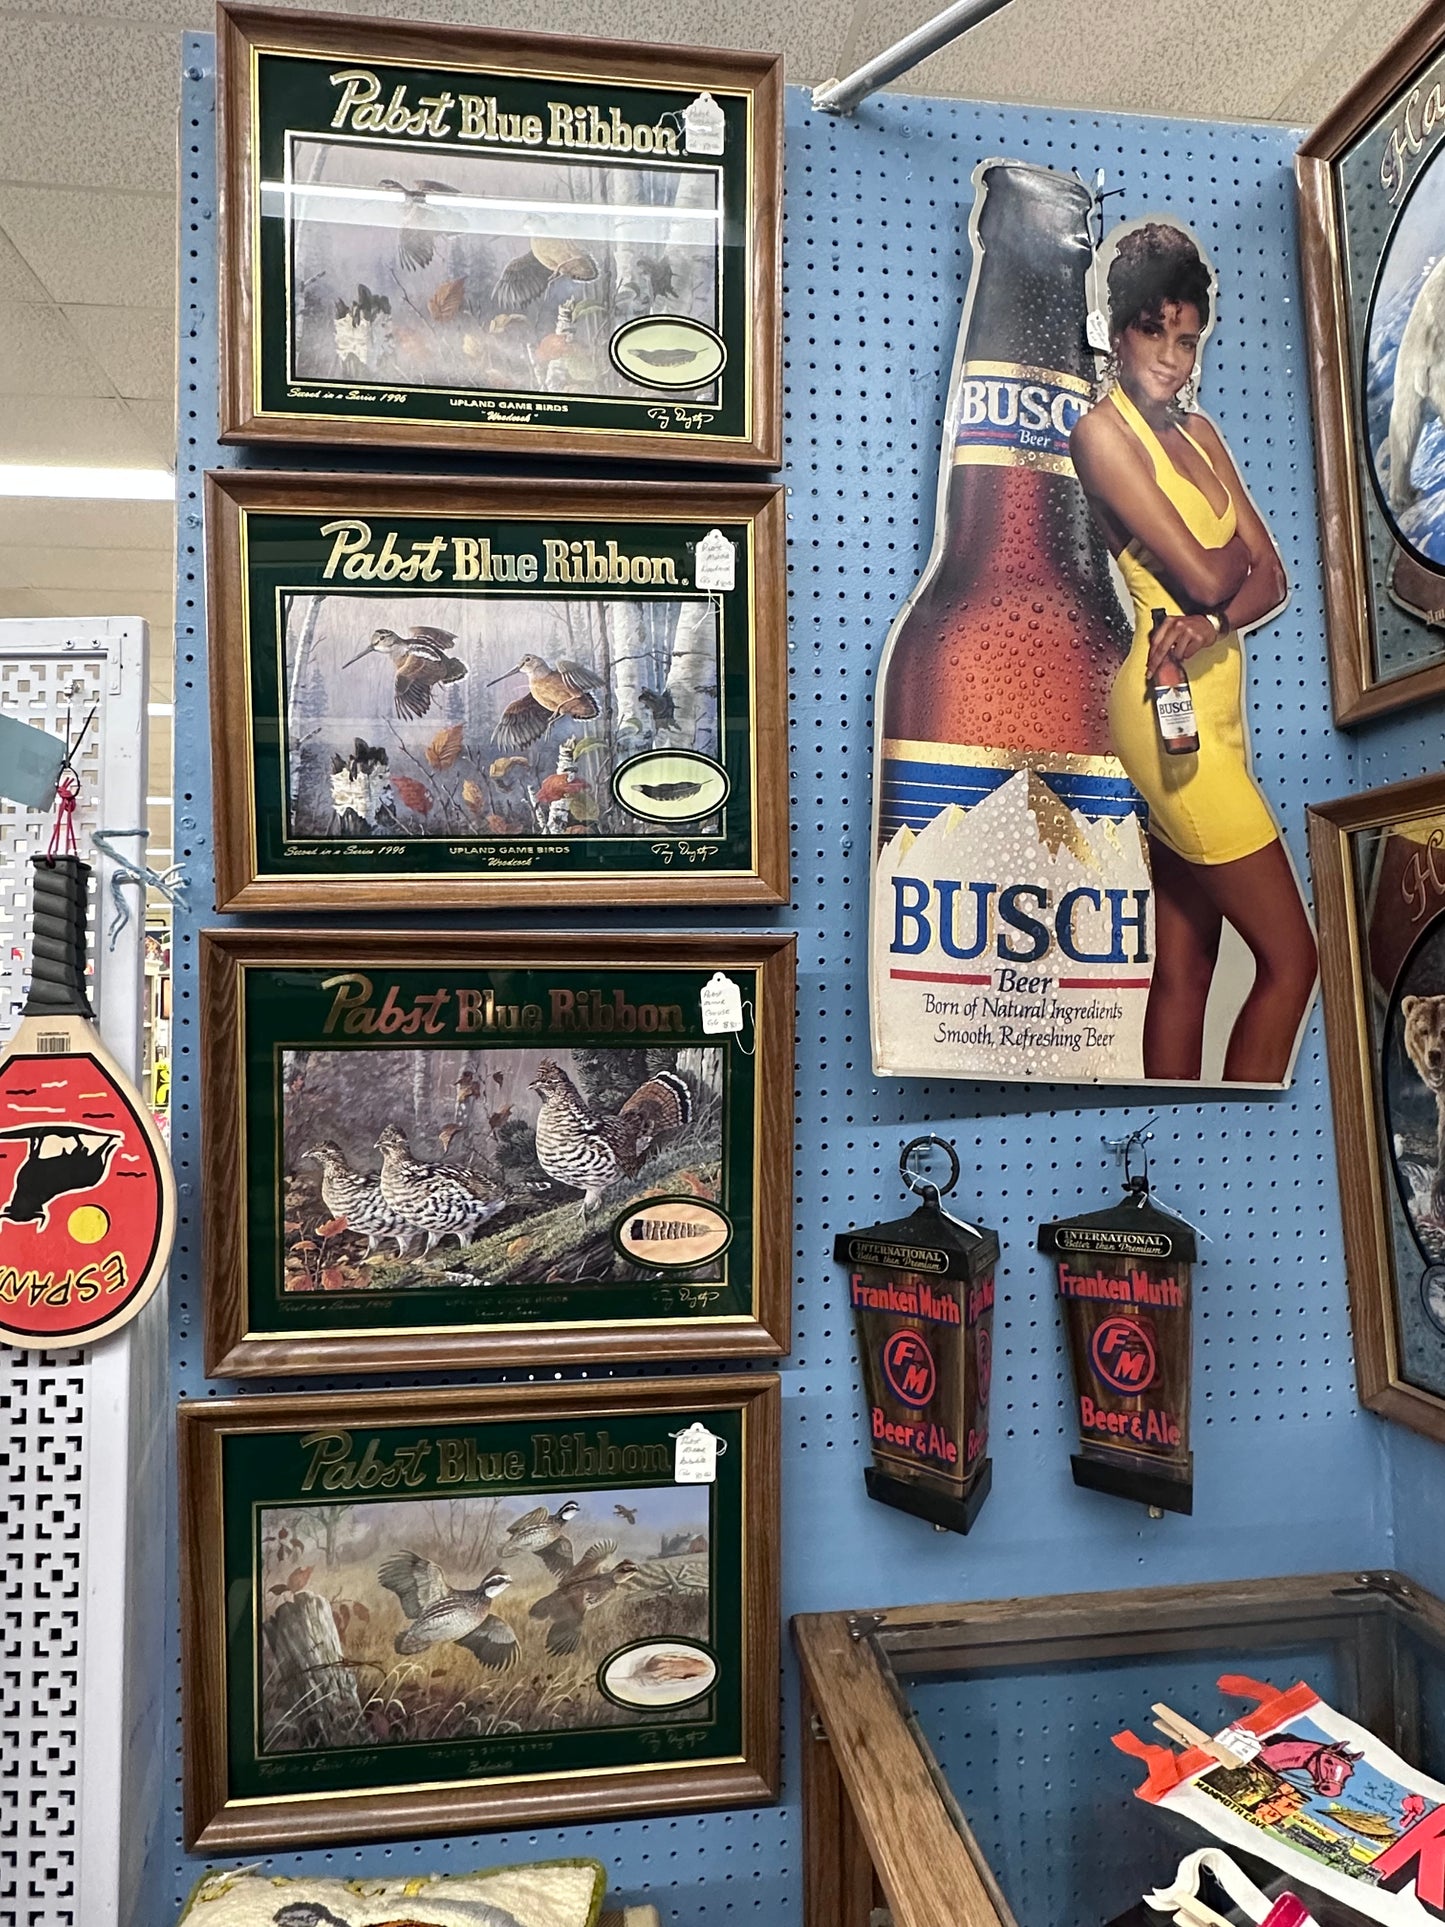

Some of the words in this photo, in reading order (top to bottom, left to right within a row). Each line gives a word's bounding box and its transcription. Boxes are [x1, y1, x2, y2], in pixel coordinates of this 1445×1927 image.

[330, 69, 455, 133] Pabst
[458, 94, 543, 143] Blue
[379, 392, 407, 403] 1996
[450, 398, 496, 409] UPLAND
[498, 401, 533, 411] GAME
[535, 403, 569, 413] BIRDS
[960, 381, 1094, 437] BUSC
[1018, 428, 1052, 447] Beer
[320, 520, 447, 581] Pabst
[451, 536, 538, 583] Blue
[1159, 700, 1193, 715] BUSCH
[377, 845, 406, 856] 1996
[449, 846, 496, 856] UPLAND
[499, 846, 534, 855] GAME
[536, 846, 570, 854] BIRDS
[890, 876, 1152, 963] BUSCH
[994, 968, 1053, 994] Beer
[321, 973, 450, 1035] Pabst
[455, 988, 542, 1034] Blue
[922, 993, 959, 1016] Born
[963, 997, 978, 1021] of
[982, 998, 1047, 1019] Natural
[1050, 1000, 1123, 1022] Ingredients
[934, 1023, 995, 1047] Smooth,
[999, 1026, 1082, 1052] Refreshing
[1083, 1027, 1115, 1047] Beer
[1063, 1230, 1164, 1246] INTERNATIONAL
[1063, 1238, 1090, 1249] Better
[1095, 1241, 1116, 1251] than
[1118, 1242, 1163, 1255] Premium
[856, 1242, 942, 1263] INTERNATIONAL
[882, 1254, 900, 1265] than
[902, 1256, 941, 1270] Premium
[0, 1251, 129, 1307] ESPAÑ
[1081, 1396, 1127, 1435] Beer
[1130, 1418, 1143, 1443] &
[1146, 1409, 1181, 1446] Ale
[872, 1407, 914, 1446] Beer
[916, 1430, 926, 1452] &
[929, 1424, 957, 1463] Ale
[300, 1430, 432, 1492] Pabst
[436, 1437, 526, 1484] Blue
[1193, 1781, 1245, 1816] MAMMOTH
[1243, 1811, 1269, 1831] CAVE
[1346, 1794, 1389, 1816] TOBACCO
[1292, 1813, 1330, 1838] CAPITOL
